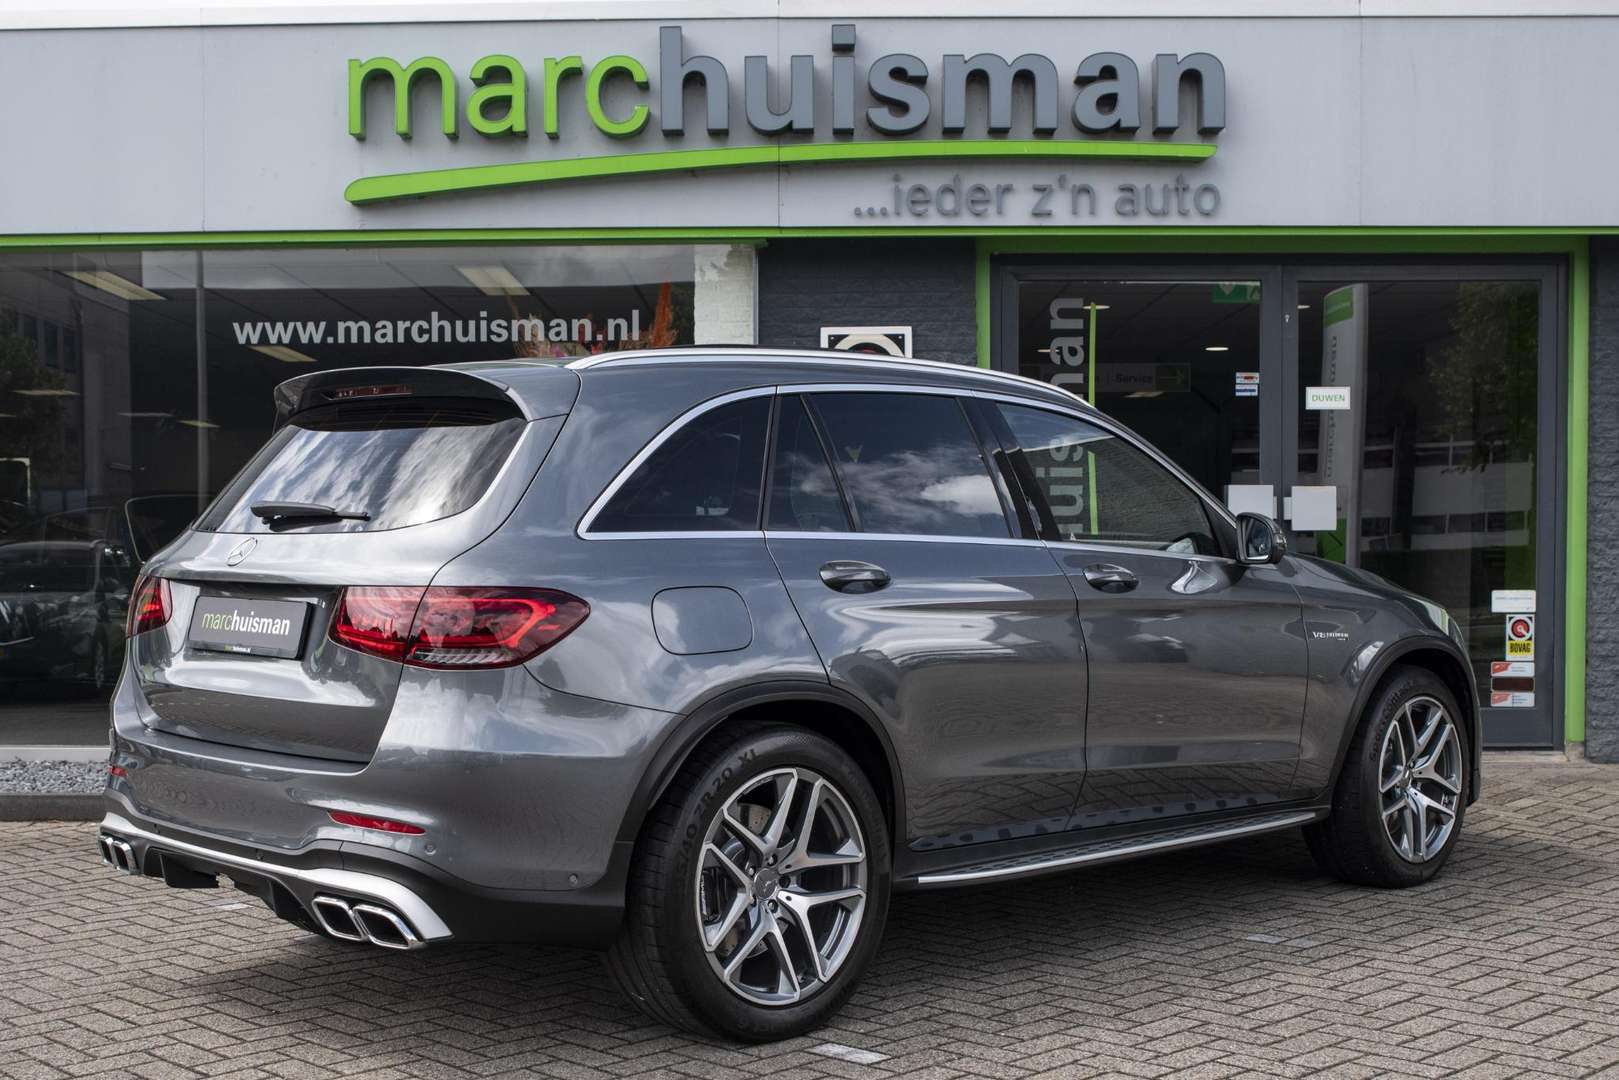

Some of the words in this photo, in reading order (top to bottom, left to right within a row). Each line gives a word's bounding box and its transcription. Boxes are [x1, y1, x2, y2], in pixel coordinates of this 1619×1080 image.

[348, 26, 1227, 137] marchuisman
[1113, 173, 1222, 217] auto
[232, 309, 640, 345] www.marchuisman.nl
[1311, 393, 1346, 402] DUWEN
[201, 610, 291, 636] marchuisman
[711, 766, 733, 794] 20
[737, 748, 760, 769] XL
